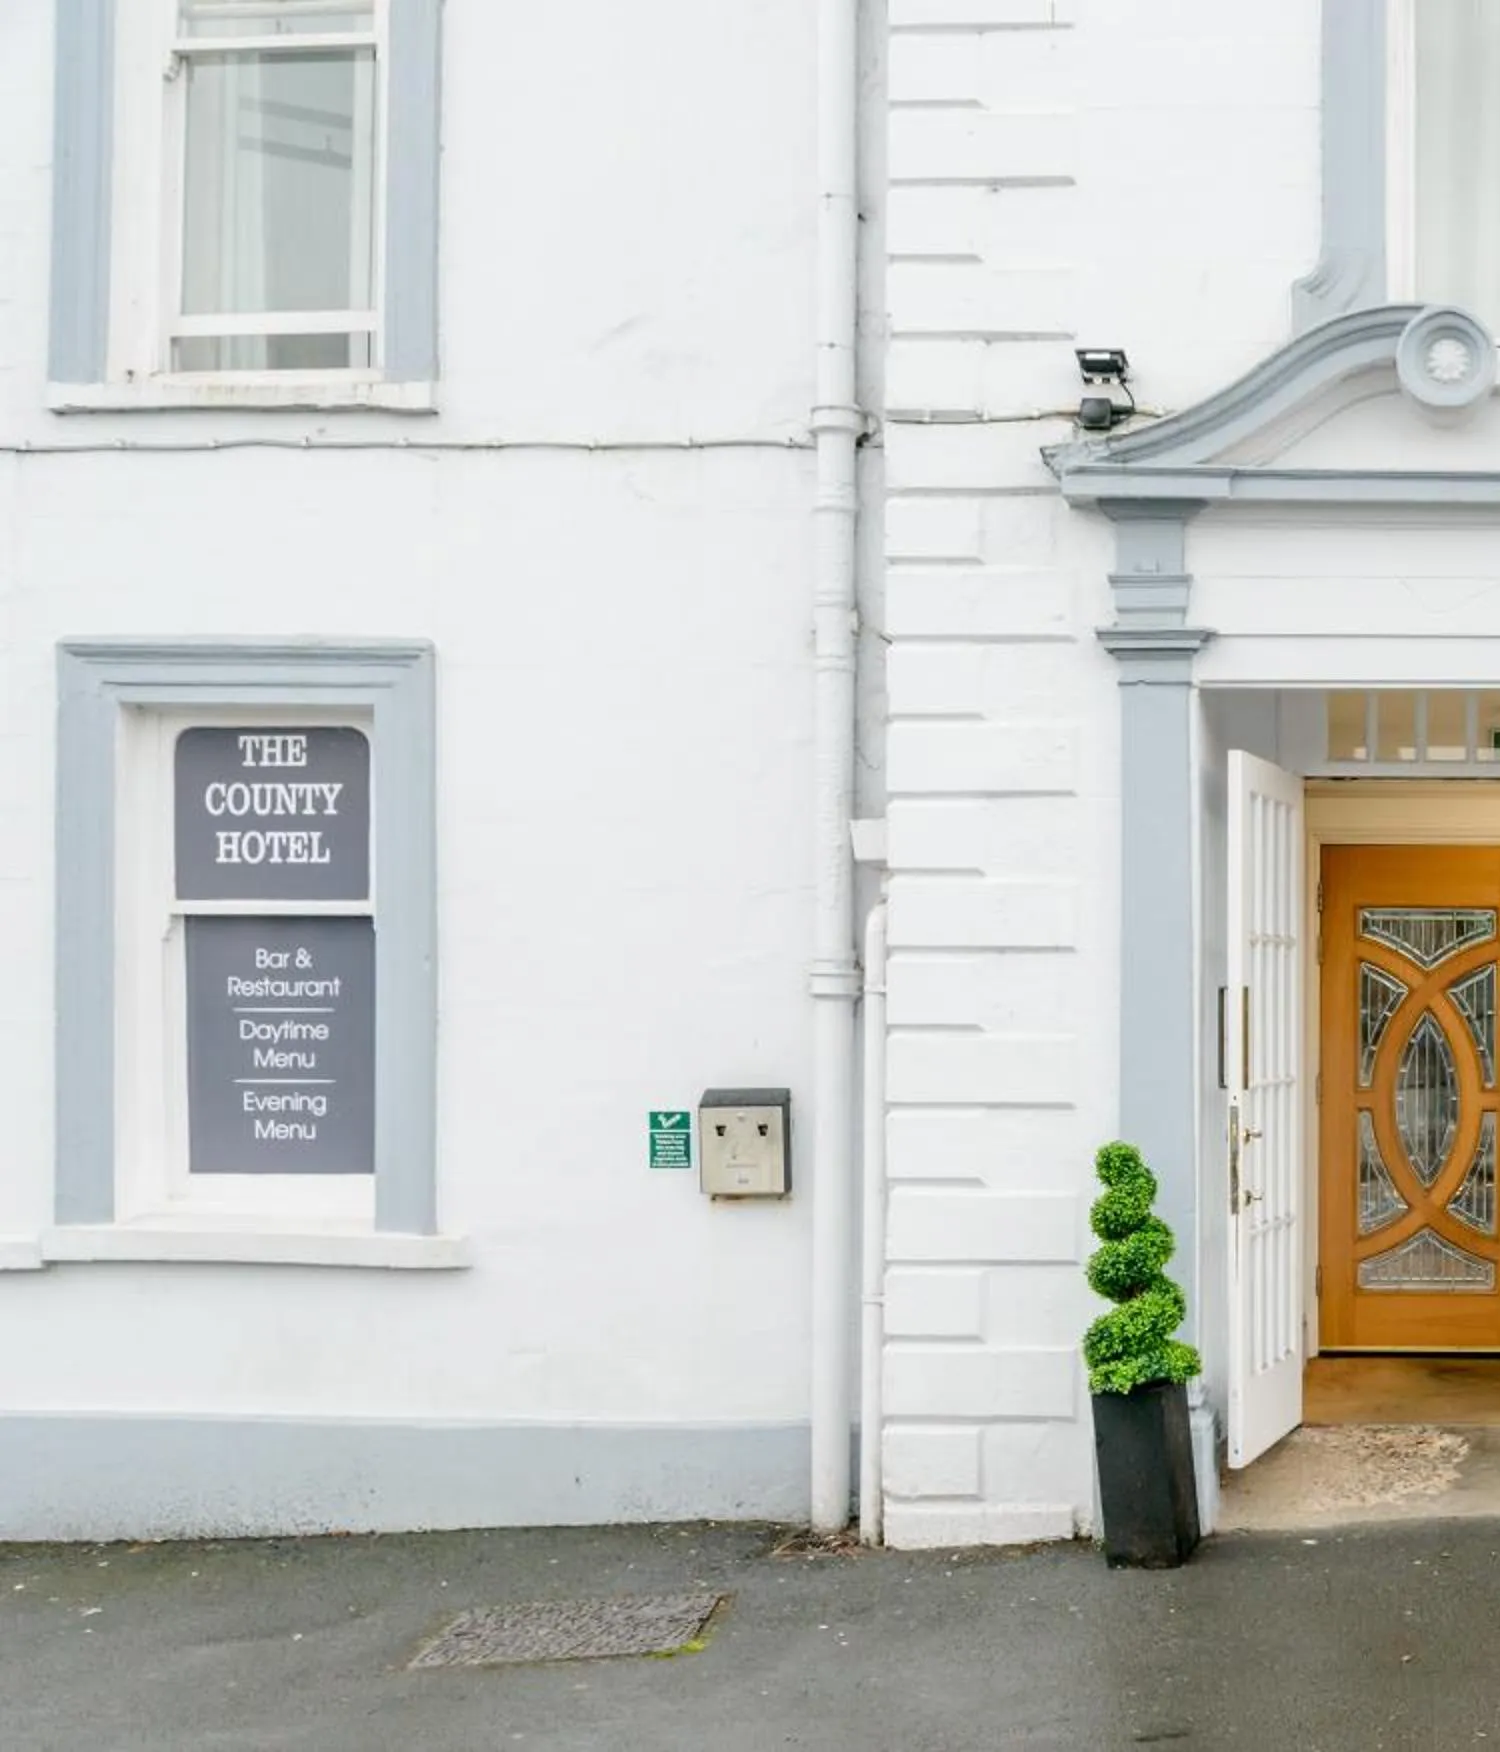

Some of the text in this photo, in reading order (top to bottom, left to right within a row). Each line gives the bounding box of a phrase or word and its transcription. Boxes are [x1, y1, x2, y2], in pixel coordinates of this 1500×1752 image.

[239, 735, 307, 767] THE
[205, 783, 343, 816] COUNTY
[215, 831, 331, 864] HOTEL
[256, 948, 312, 969] Bar &
[227, 976, 341, 998] Restaurant
[239, 1019, 329, 1044] Daytime
[254, 1049, 315, 1069] Menu
[243, 1091, 327, 1116] Evening
[255, 1119, 316, 1140] Menu
